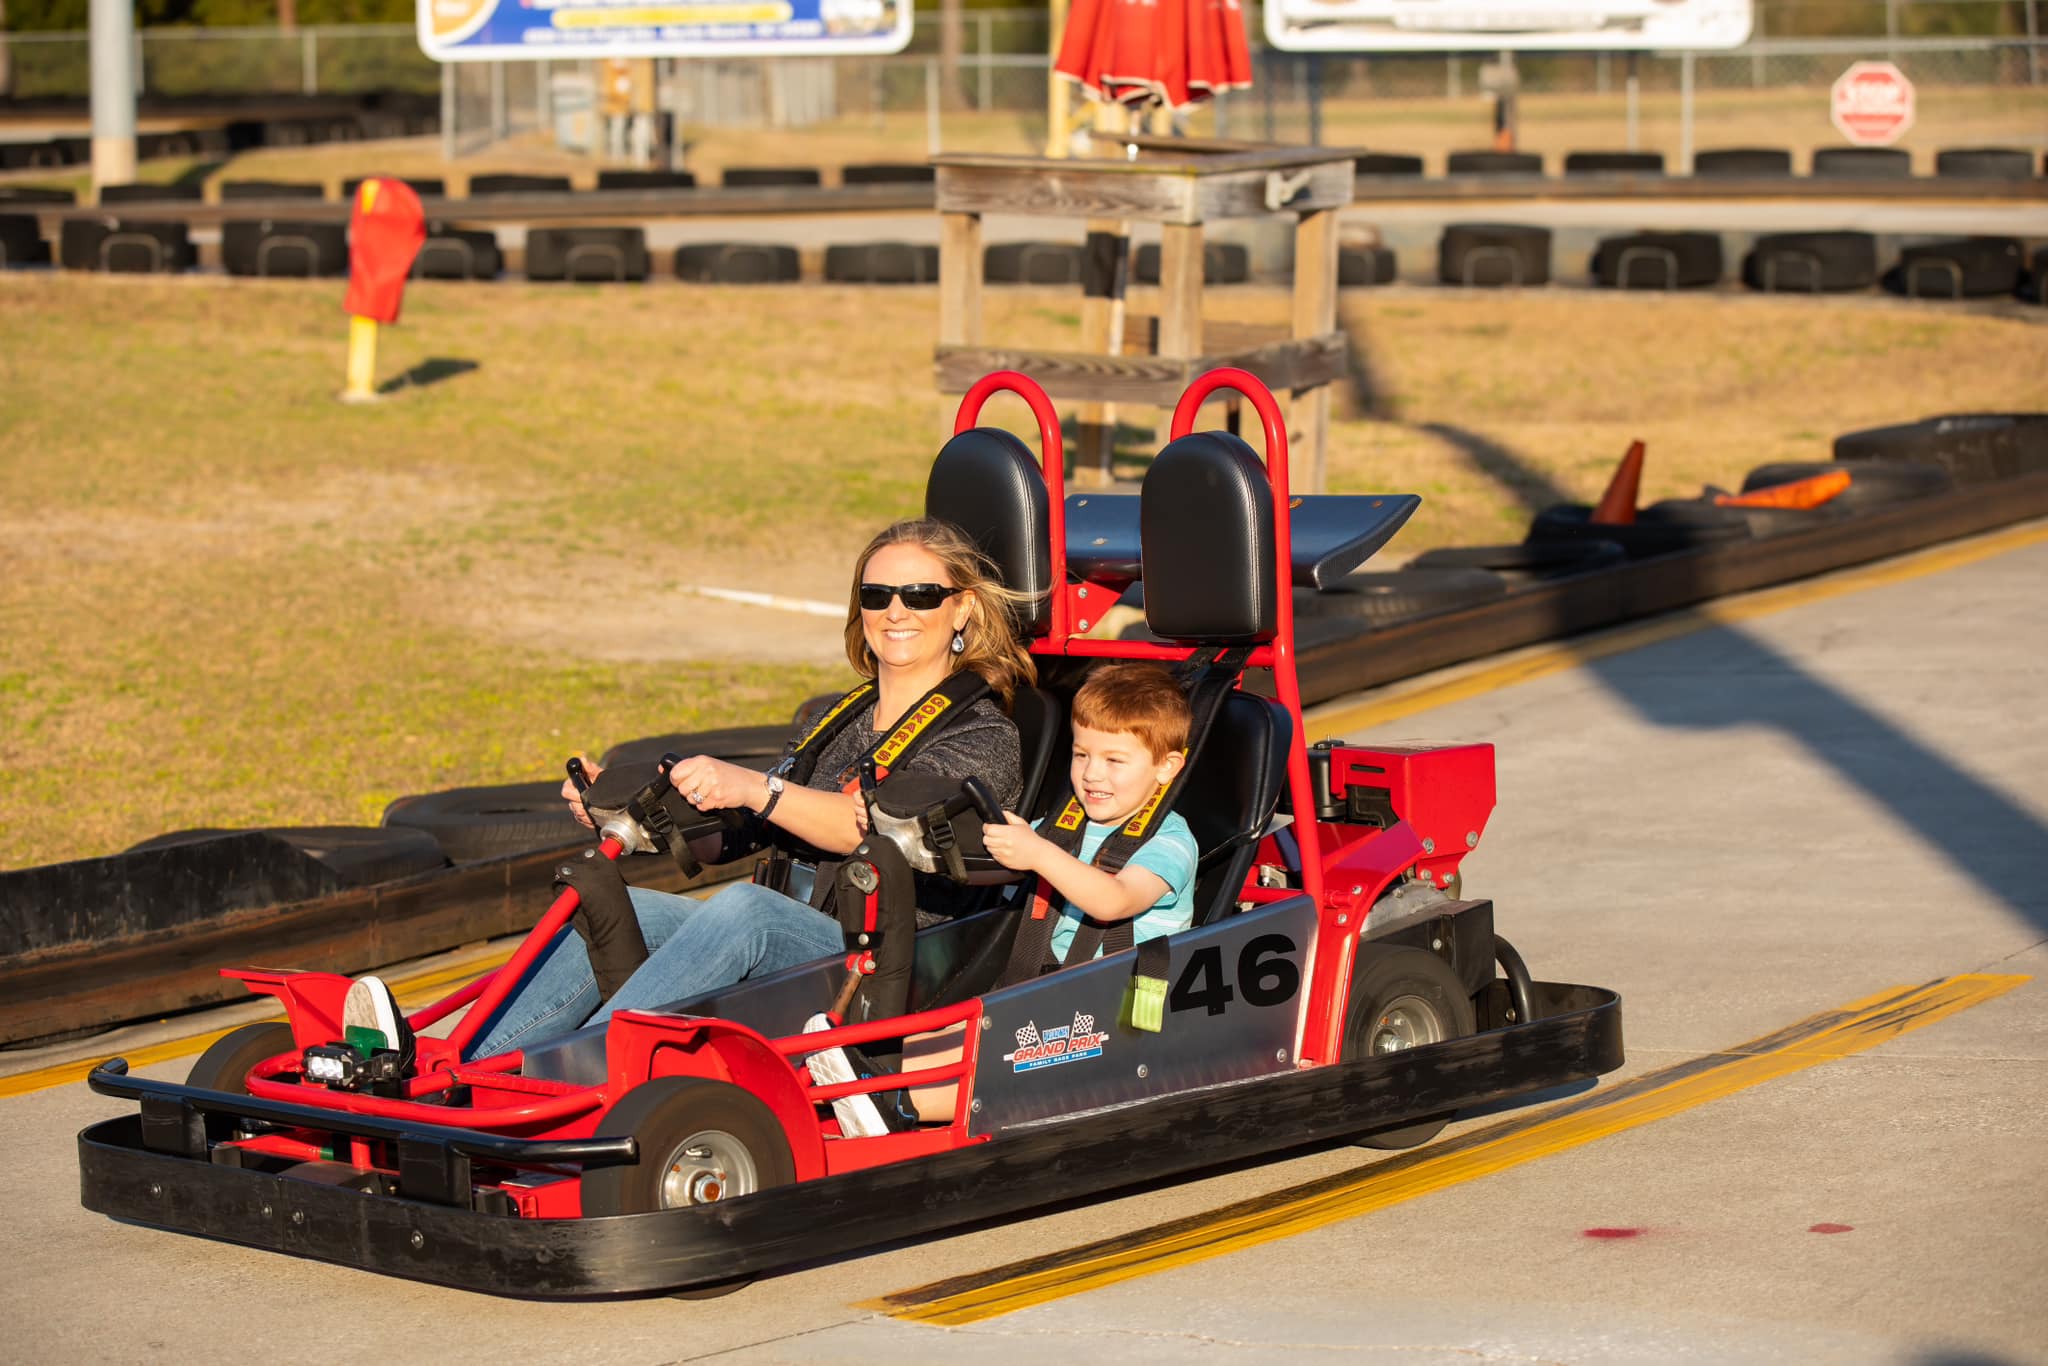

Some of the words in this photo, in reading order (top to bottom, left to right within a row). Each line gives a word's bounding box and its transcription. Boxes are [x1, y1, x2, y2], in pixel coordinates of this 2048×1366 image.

[1170, 934, 1299, 1016] 46
[1014, 1041, 1065, 1061] GRAND
[1068, 1033, 1102, 1051] PRIX
